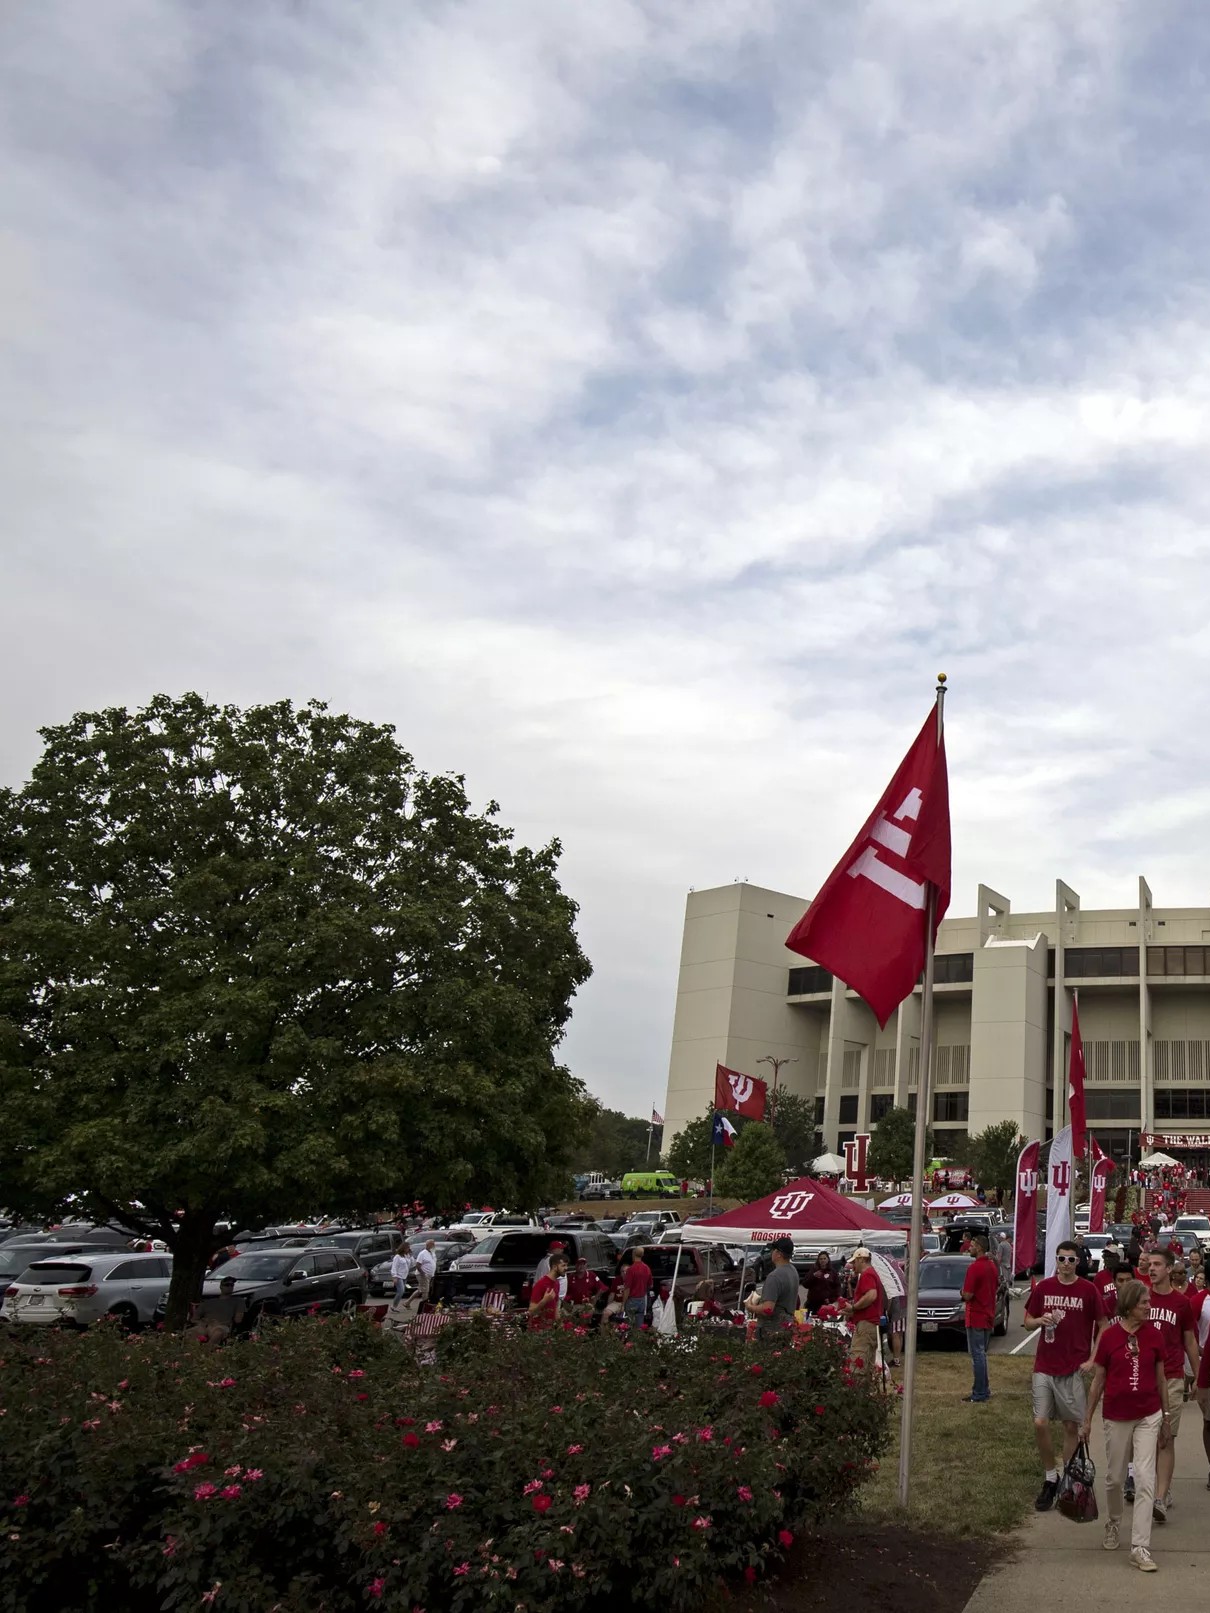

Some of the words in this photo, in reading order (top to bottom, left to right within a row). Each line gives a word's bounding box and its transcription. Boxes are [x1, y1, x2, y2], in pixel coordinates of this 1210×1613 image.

[1162, 1135, 1183, 1145] THE
[1044, 1295, 1083, 1308] INDIANA
[1150, 1308, 1177, 1326] DIANA
